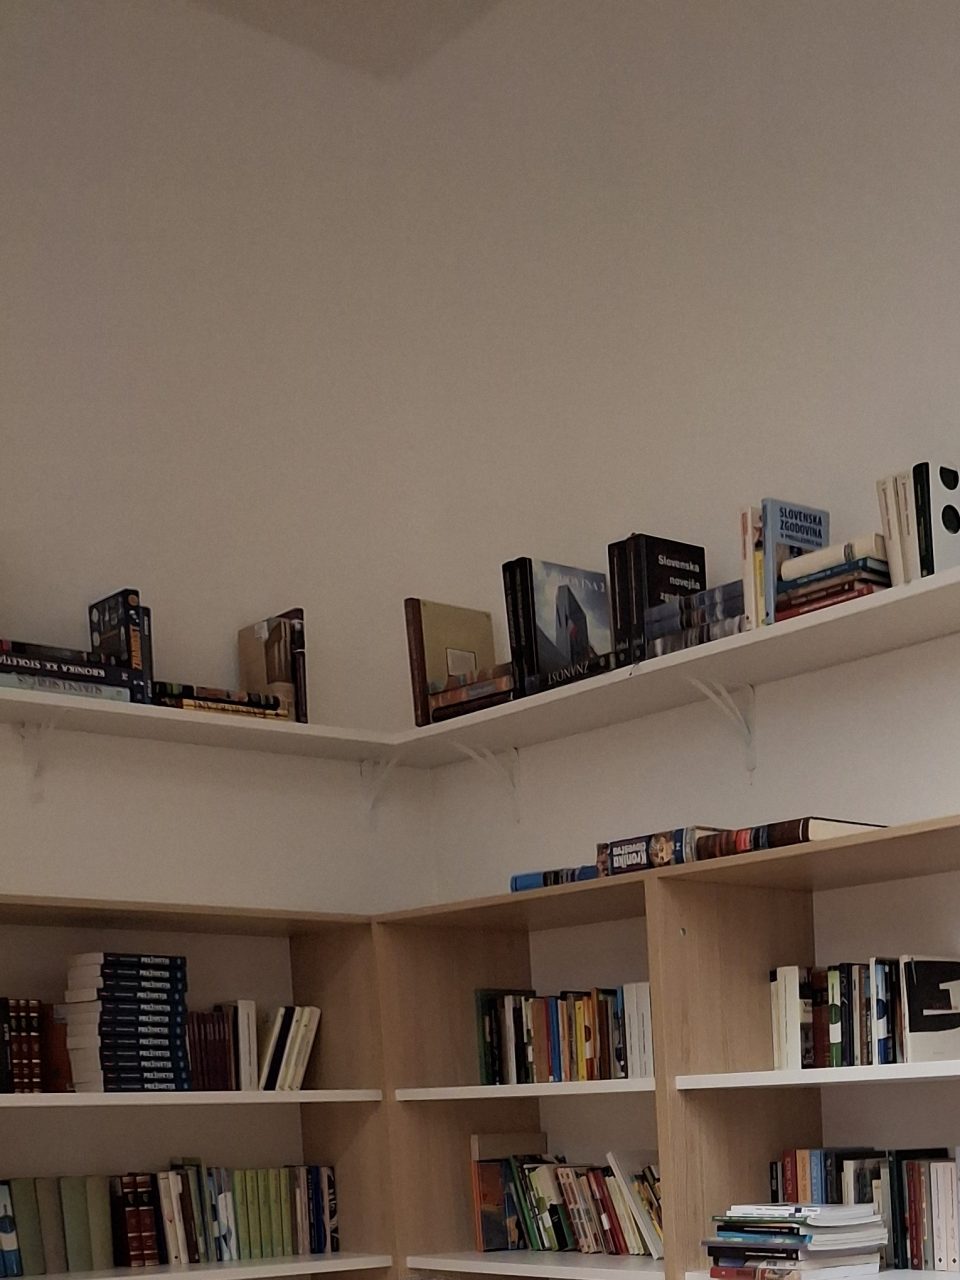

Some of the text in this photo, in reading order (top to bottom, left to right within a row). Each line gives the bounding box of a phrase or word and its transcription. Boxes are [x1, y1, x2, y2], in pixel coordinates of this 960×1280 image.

[779, 506, 822, 527] SLOVENSKA
[779, 519, 822, 539] ZGODOVINA
[657, 554, 700, 573] Slovenska
[669, 575, 701, 590] novejša
[61, 664, 105, 677] KRONIKA
[548, 661, 589, 684] ZNANOST
[613, 852, 646, 867] Kronika
